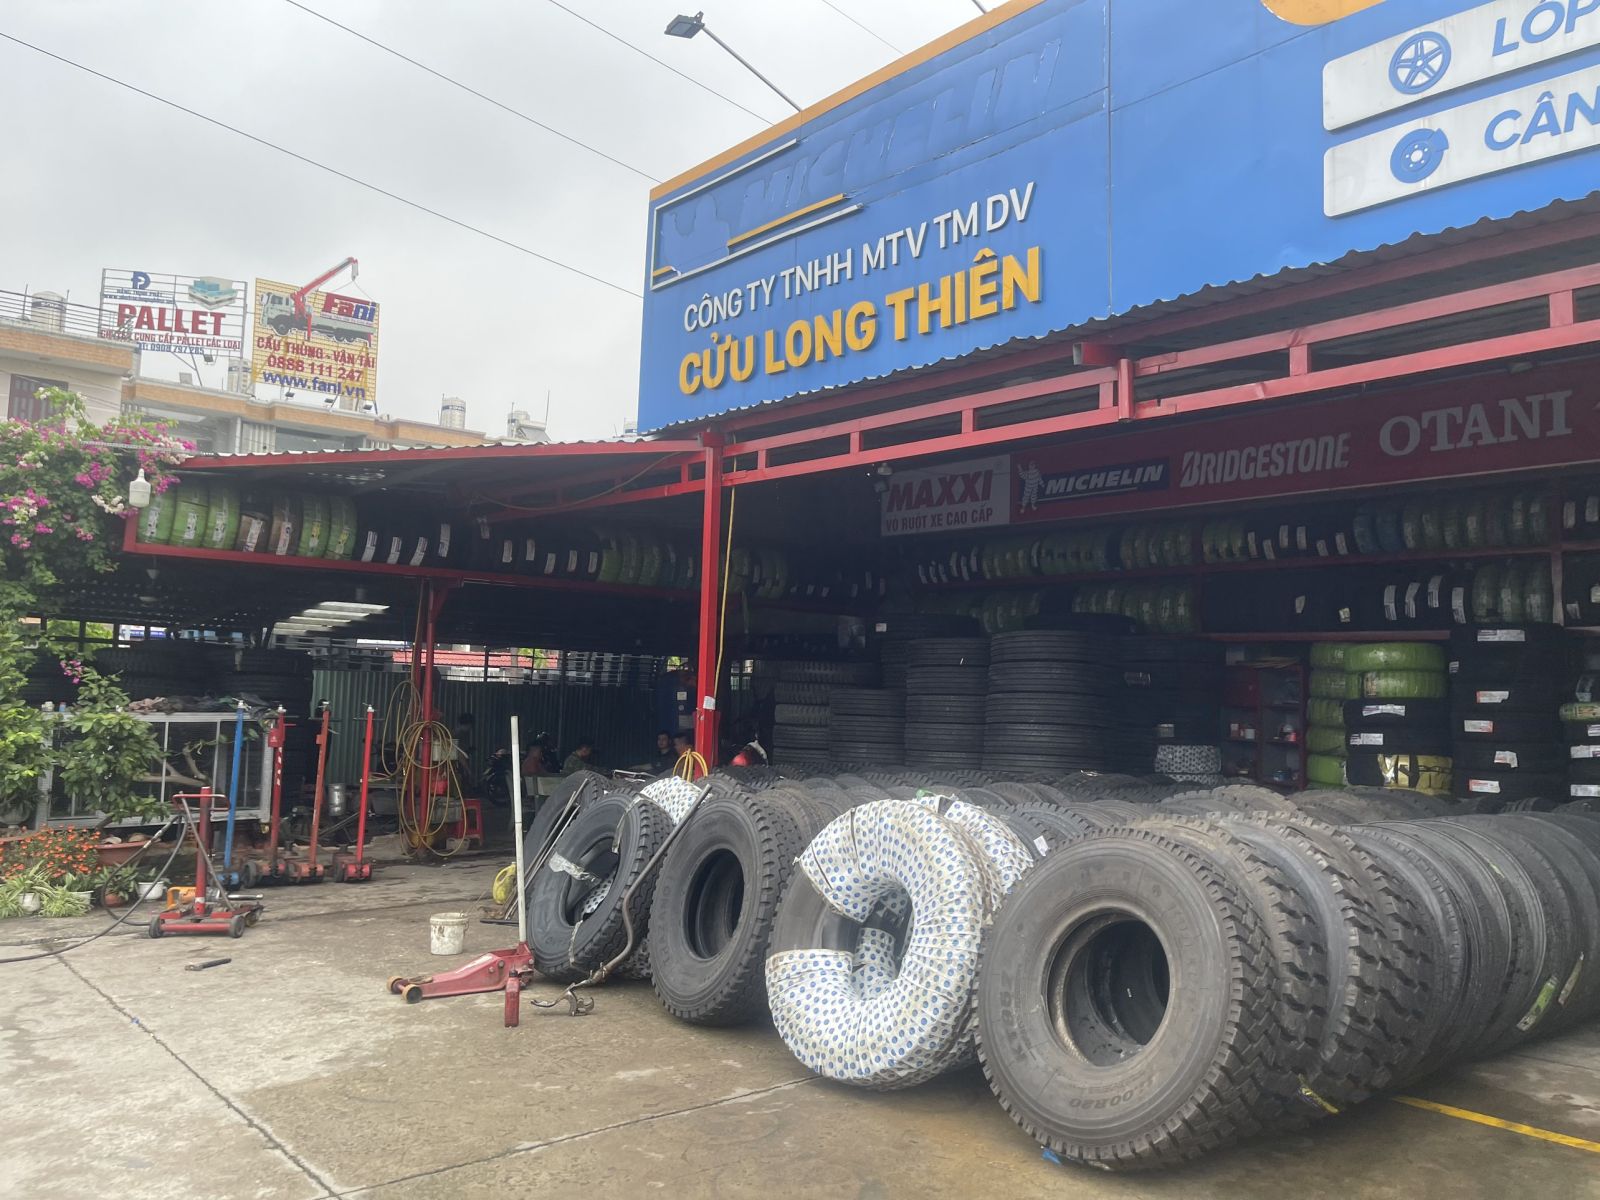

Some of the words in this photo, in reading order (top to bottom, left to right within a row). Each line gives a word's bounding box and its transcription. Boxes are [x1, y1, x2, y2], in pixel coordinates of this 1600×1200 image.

[684, 287, 743, 332] CÔNG
[746, 274, 776, 311] TY
[780, 247, 853, 299] TNHH
[862, 221, 927, 275] MTV
[933, 201, 979, 249] TM
[986, 181, 1036, 232] DV
[118, 303, 226, 337] PALLET
[679, 331, 755, 395] CỬU
[764, 301, 877, 375] LONG
[885, 245, 1041, 341] THIÊN
[134, 332, 156, 342] CUNG
[176, 335, 206, 347] PALLET
[309, 361, 333, 377] 111
[338, 366, 364, 382] 247
[1379, 389, 1573, 457] OTANI
[1179, 431, 1352, 488] BRIDGESTONE
[1045, 464, 1164, 495] MICHELIN
[930, 513, 943, 528] XE
[946, 510, 968, 526] CAO
[971, 502, 993, 524] CẤP
